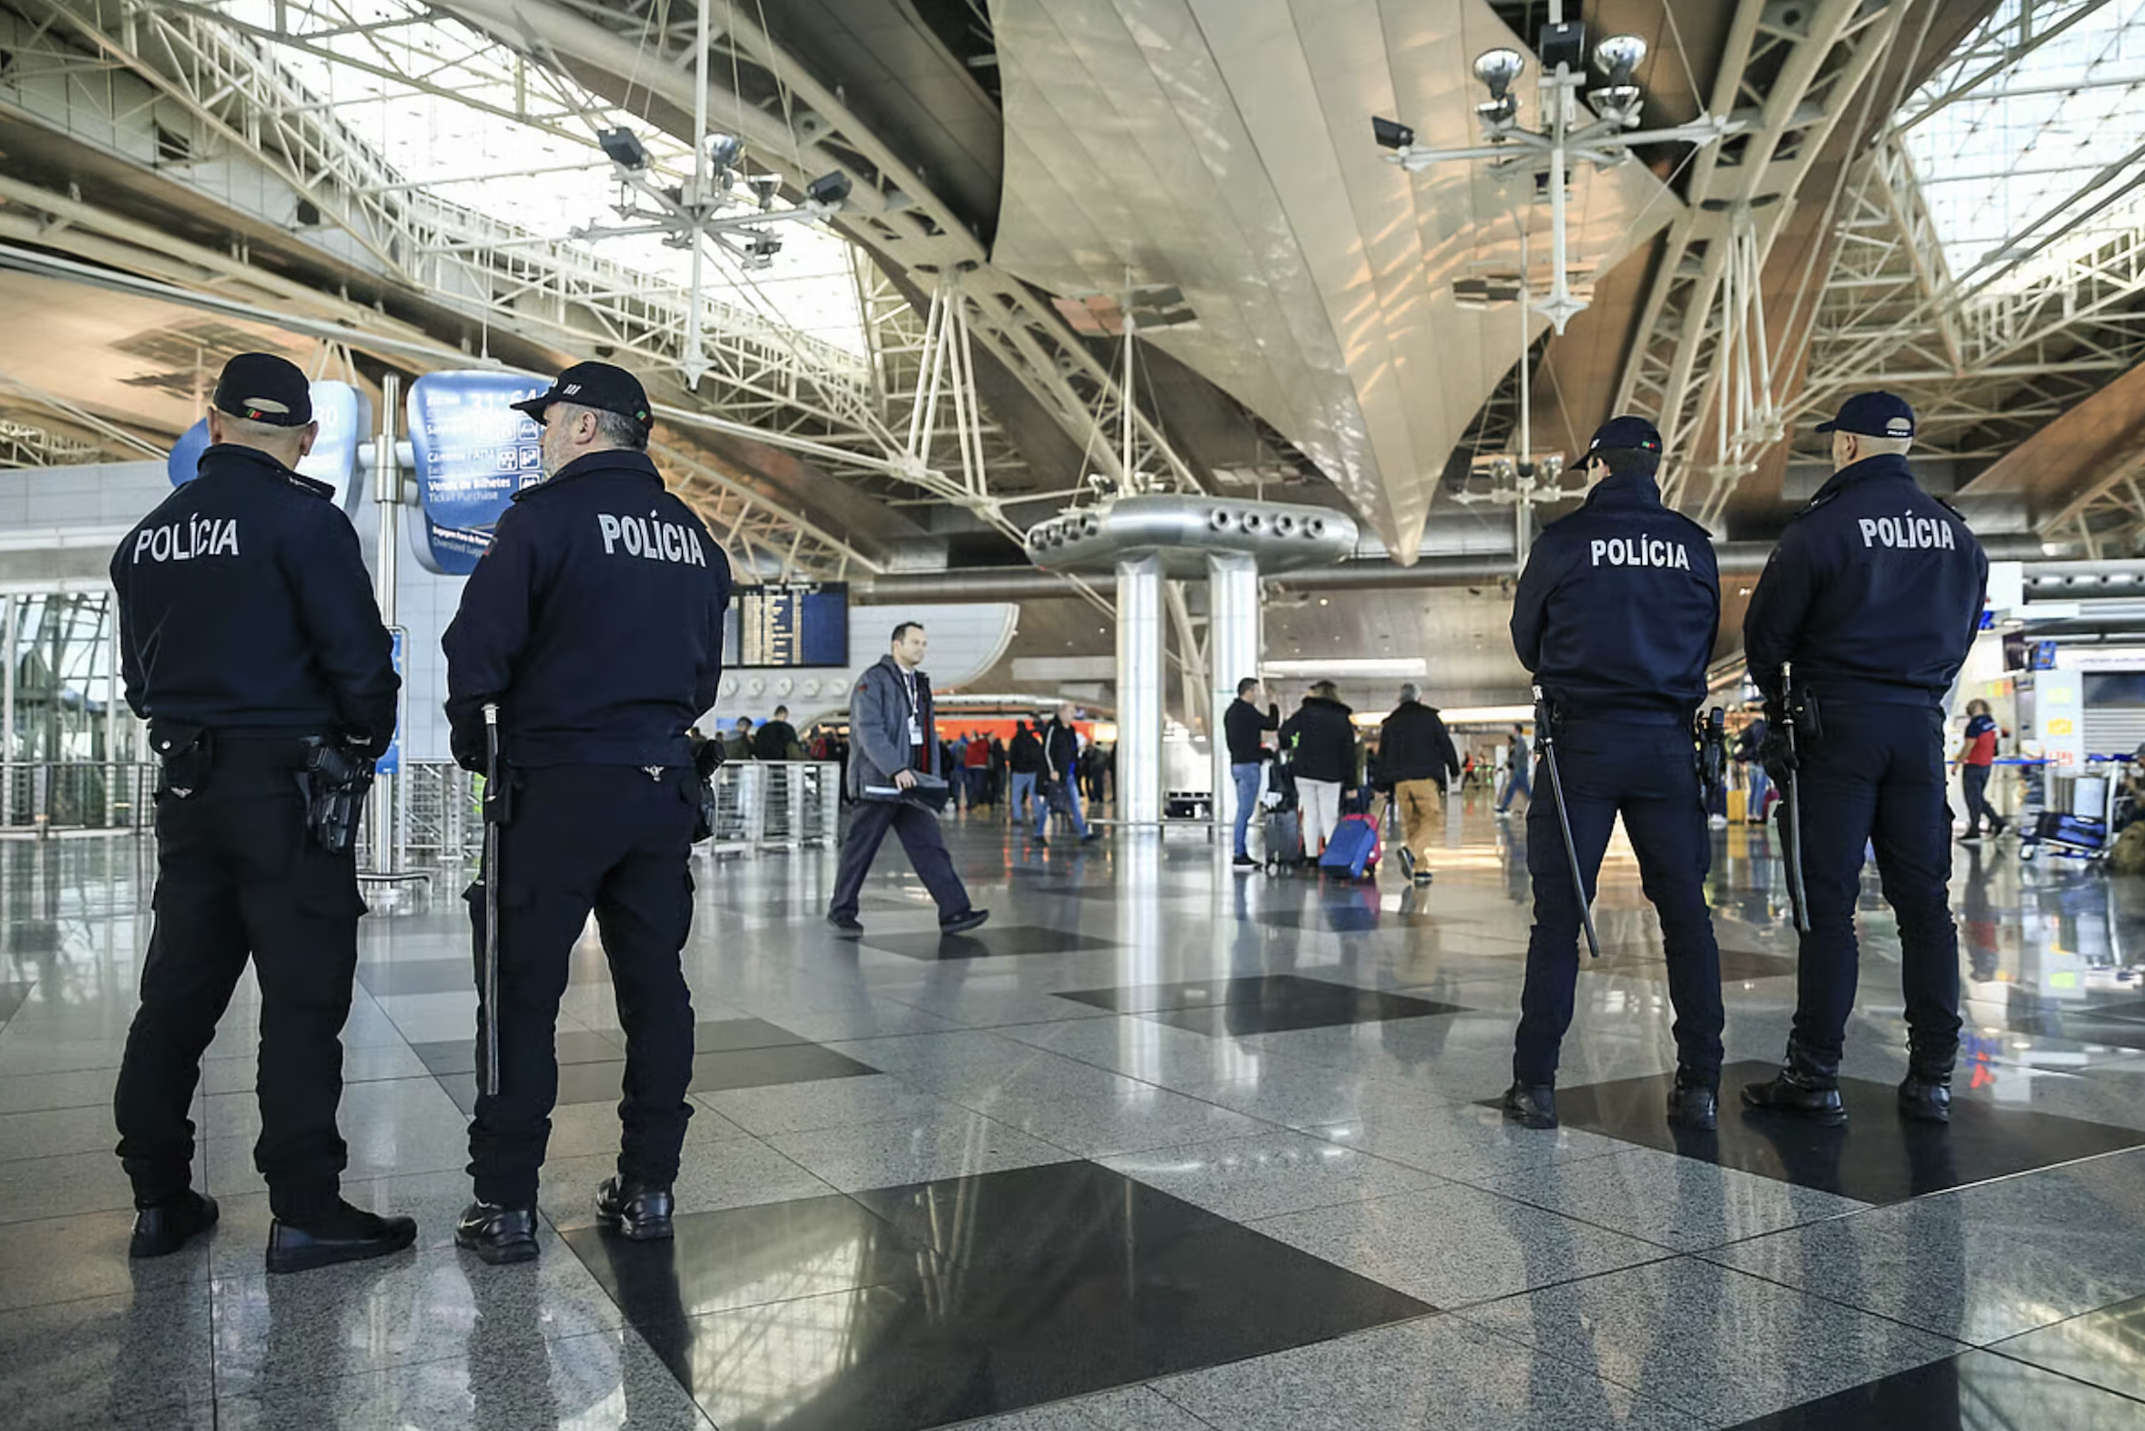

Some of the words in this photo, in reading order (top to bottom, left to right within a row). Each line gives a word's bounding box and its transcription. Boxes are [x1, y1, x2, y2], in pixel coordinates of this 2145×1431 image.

[474, 477, 511, 488] Bilhetes
[133, 512, 239, 564] POLÍCIA
[597, 509, 706, 568] POLÍCIA
[1858, 509, 1955, 551] POLÍCIA
[1591, 534, 1690, 571] POLÍCIA
